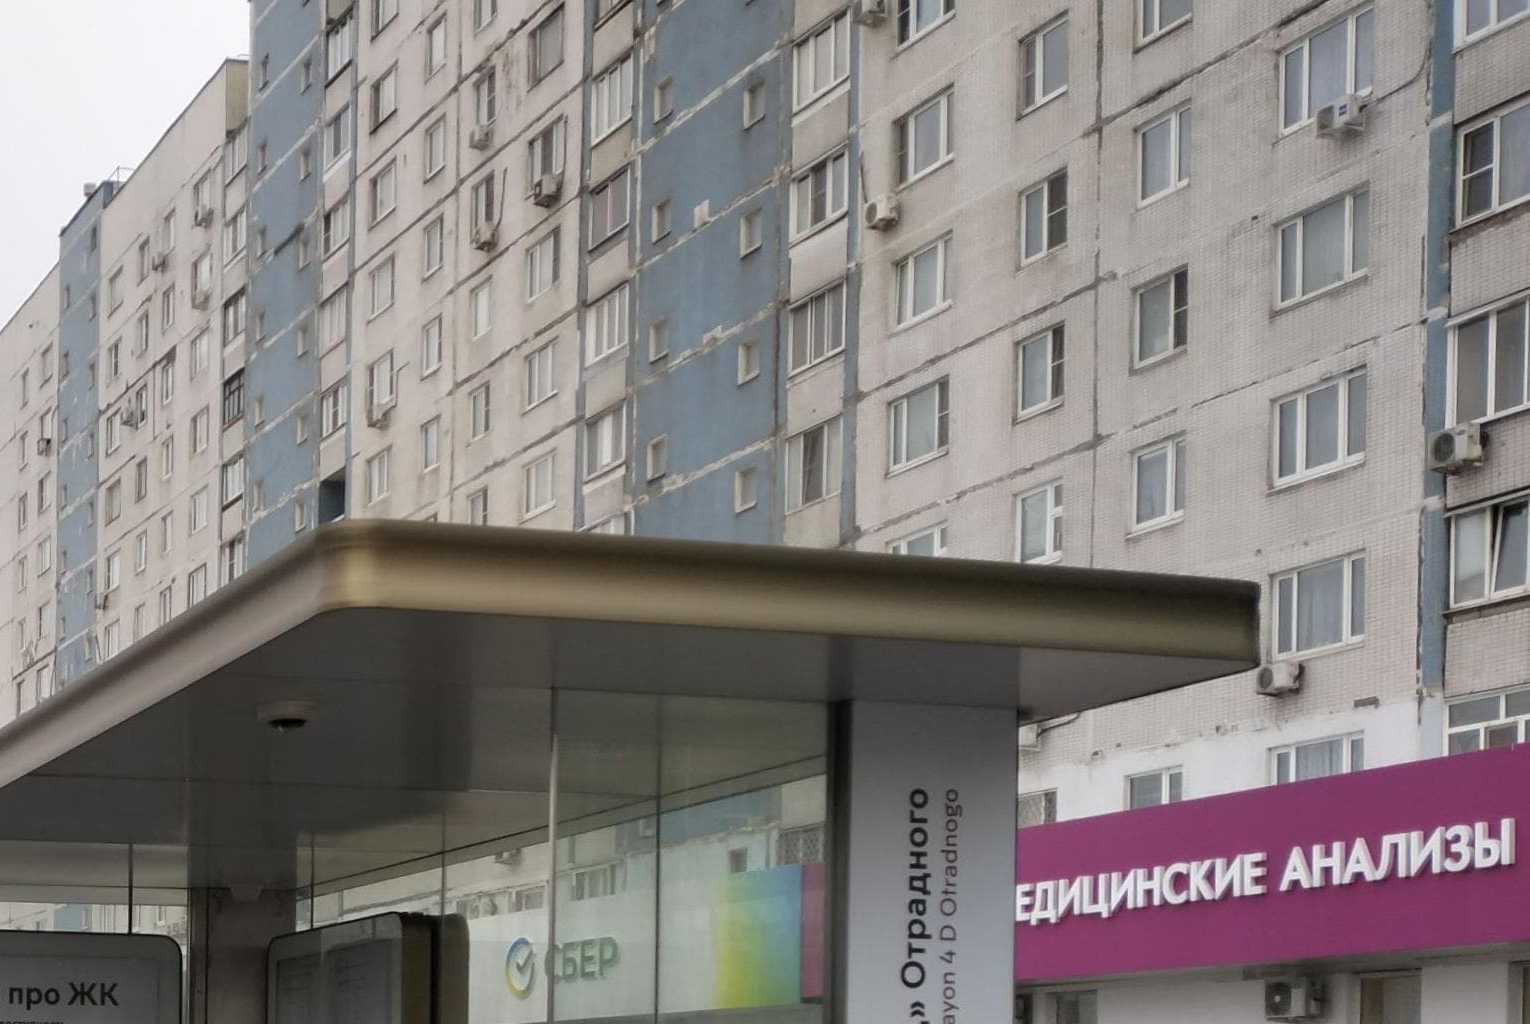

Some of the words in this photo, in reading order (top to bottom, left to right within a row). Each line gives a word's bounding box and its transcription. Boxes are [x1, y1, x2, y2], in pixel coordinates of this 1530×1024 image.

[939, 787, 962, 917] Otradnogo
[1015, 851, 1268, 926] ЕДИЦИНСКИЕ
[1278, 817, 1516, 892] АНАЛИЗЫ
[900, 787, 932, 989] Отрадного
[939, 949, 956, 964] 4
[940, 925, 957, 942] D
[544, 936, 619, 985] СБЕР
[8, 986, 61, 1011] про
[66, 982, 120, 1007] ЖК
